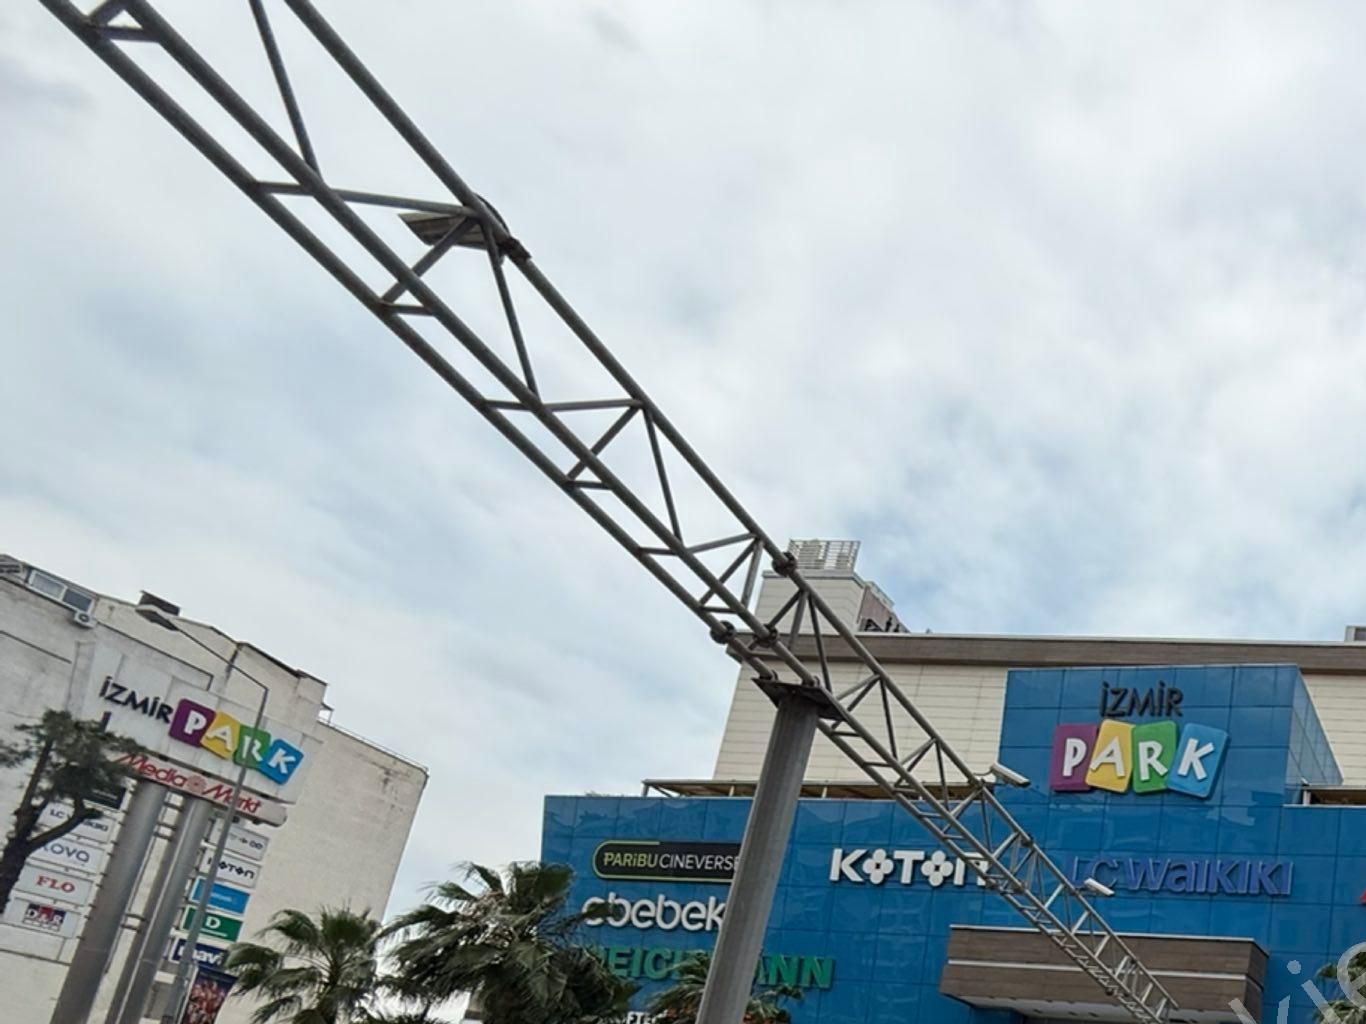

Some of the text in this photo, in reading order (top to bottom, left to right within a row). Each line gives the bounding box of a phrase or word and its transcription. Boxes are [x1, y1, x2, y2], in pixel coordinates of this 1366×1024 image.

[1101, 680, 1184, 718] İZMİR
[99, 676, 297, 775] İZMİR PARK
[1062, 736, 1215, 782] PARK
[36, 875, 75, 893] FLO
[178, 944, 223, 966] avi
